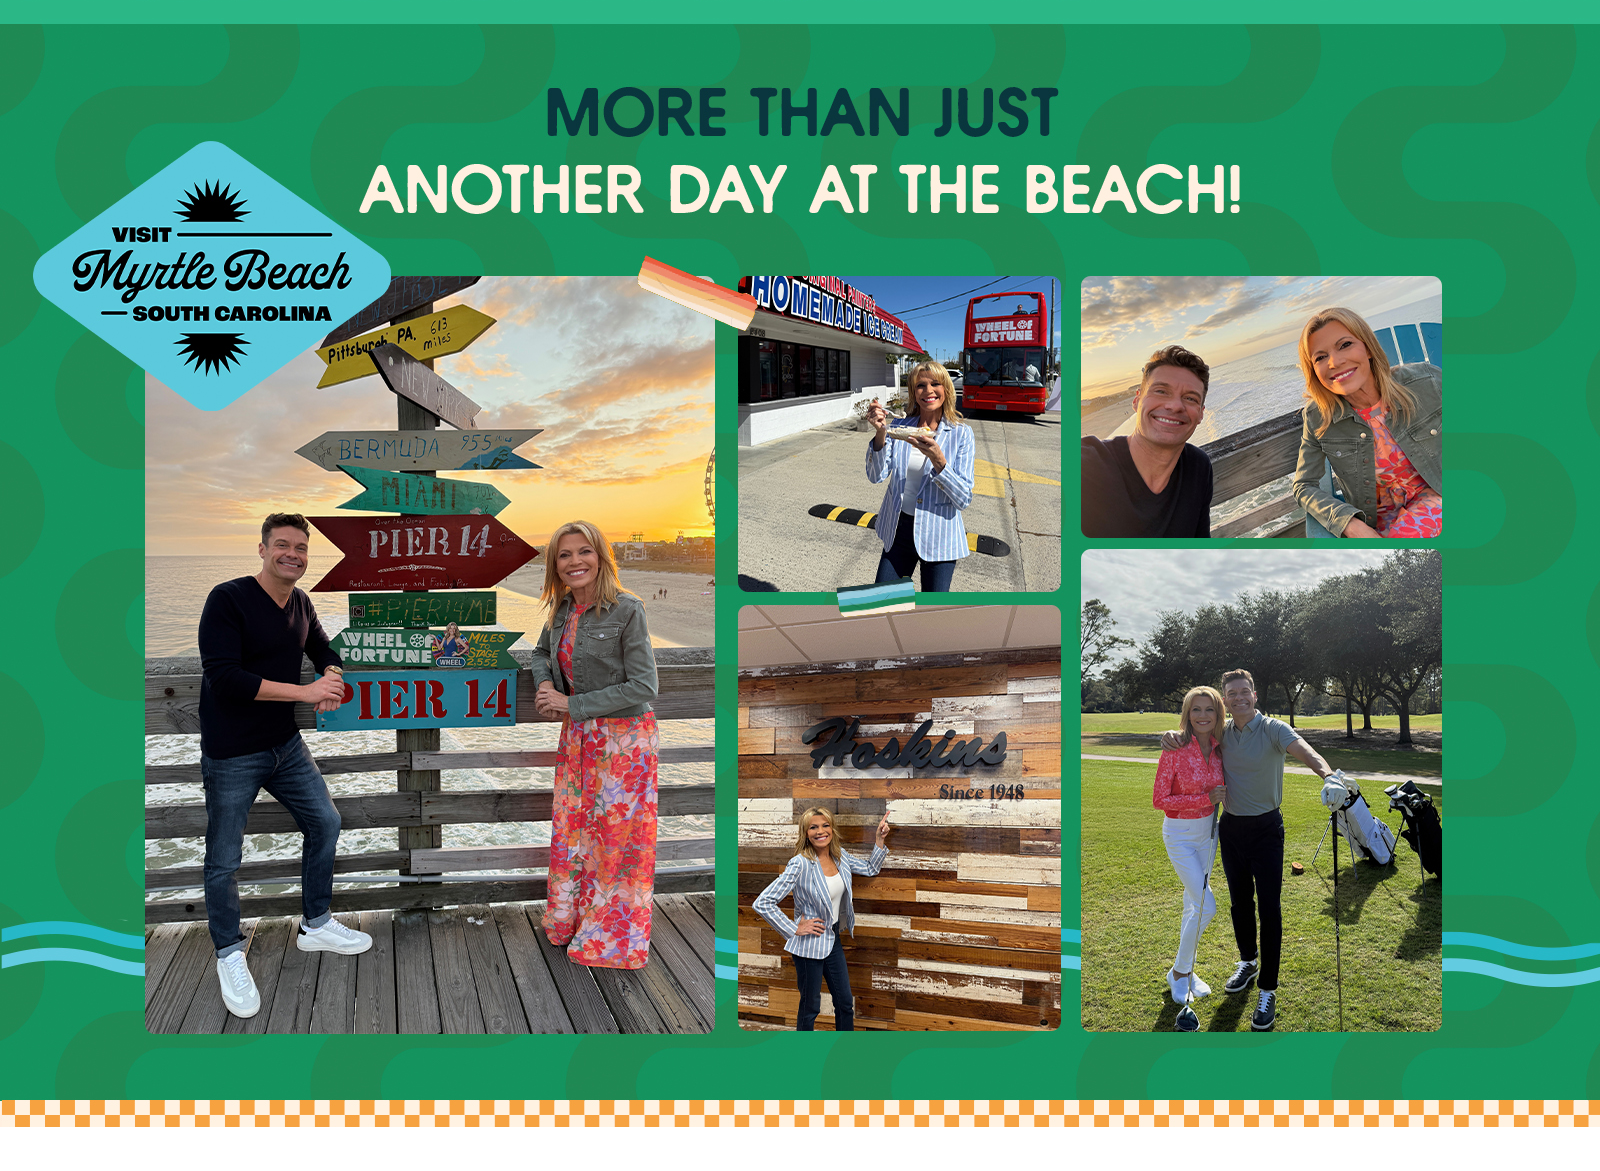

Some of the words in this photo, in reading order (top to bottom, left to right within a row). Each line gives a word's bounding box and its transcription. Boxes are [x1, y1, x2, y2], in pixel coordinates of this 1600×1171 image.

[751, 276, 861, 334] HOMEMADE
[863, 310, 880, 338] ICE
[880, 318, 904, 345] CREAM
[430, 317, 448, 335] 613
[975, 321, 1017, 332] WHEEL
[1017, 319, 1033, 330] OF
[397, 326, 416, 344] PA.
[423, 332, 451, 351] miles
[974, 330, 1033, 343] FORTUNE
[401, 357, 431, 404] NEW
[338, 437, 440, 460] BERMUDA
[461, 434, 492, 451] 955
[382, 476, 456, 510] MIAMI
[369, 527, 450, 558] PIER
[458, 524, 492, 557] 14
[413, 577, 425, 587] and
[430, 577, 453, 588] Fishing
[456, 578, 469, 587] Pier
[340, 632, 406, 648] WHEEL
[409, 633, 434, 648] OF
[468, 632, 505, 645] MILES
[340, 648, 432, 664] FORTUNE
[468, 647, 500, 659] STAGE
[467, 659, 498, 667] 2,552
[464, 679, 512, 719] 14
[801, 717, 1008, 770] Hoskins
[939, 783, 984, 801] Since
[989, 784, 1025, 802] 1948
